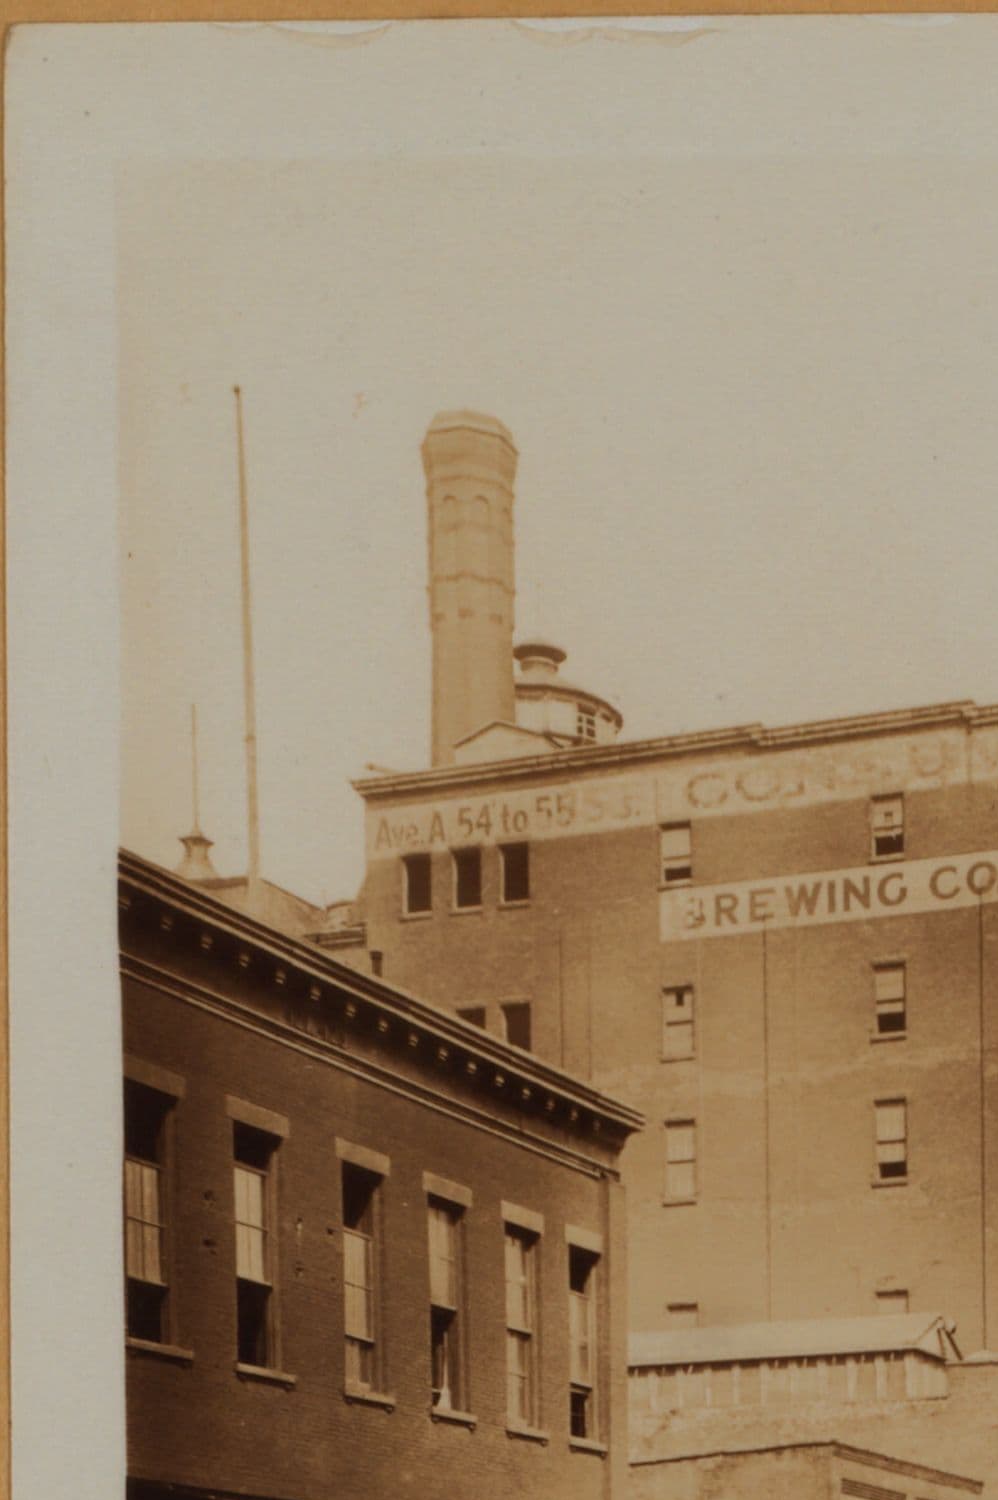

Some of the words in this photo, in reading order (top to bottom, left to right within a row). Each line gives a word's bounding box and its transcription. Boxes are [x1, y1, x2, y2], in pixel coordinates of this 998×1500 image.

[428, 810, 446, 844] A
[503, 803, 529, 833] to
[684, 872, 908, 930] BREWING
[929, 860, 998, 901] CO
